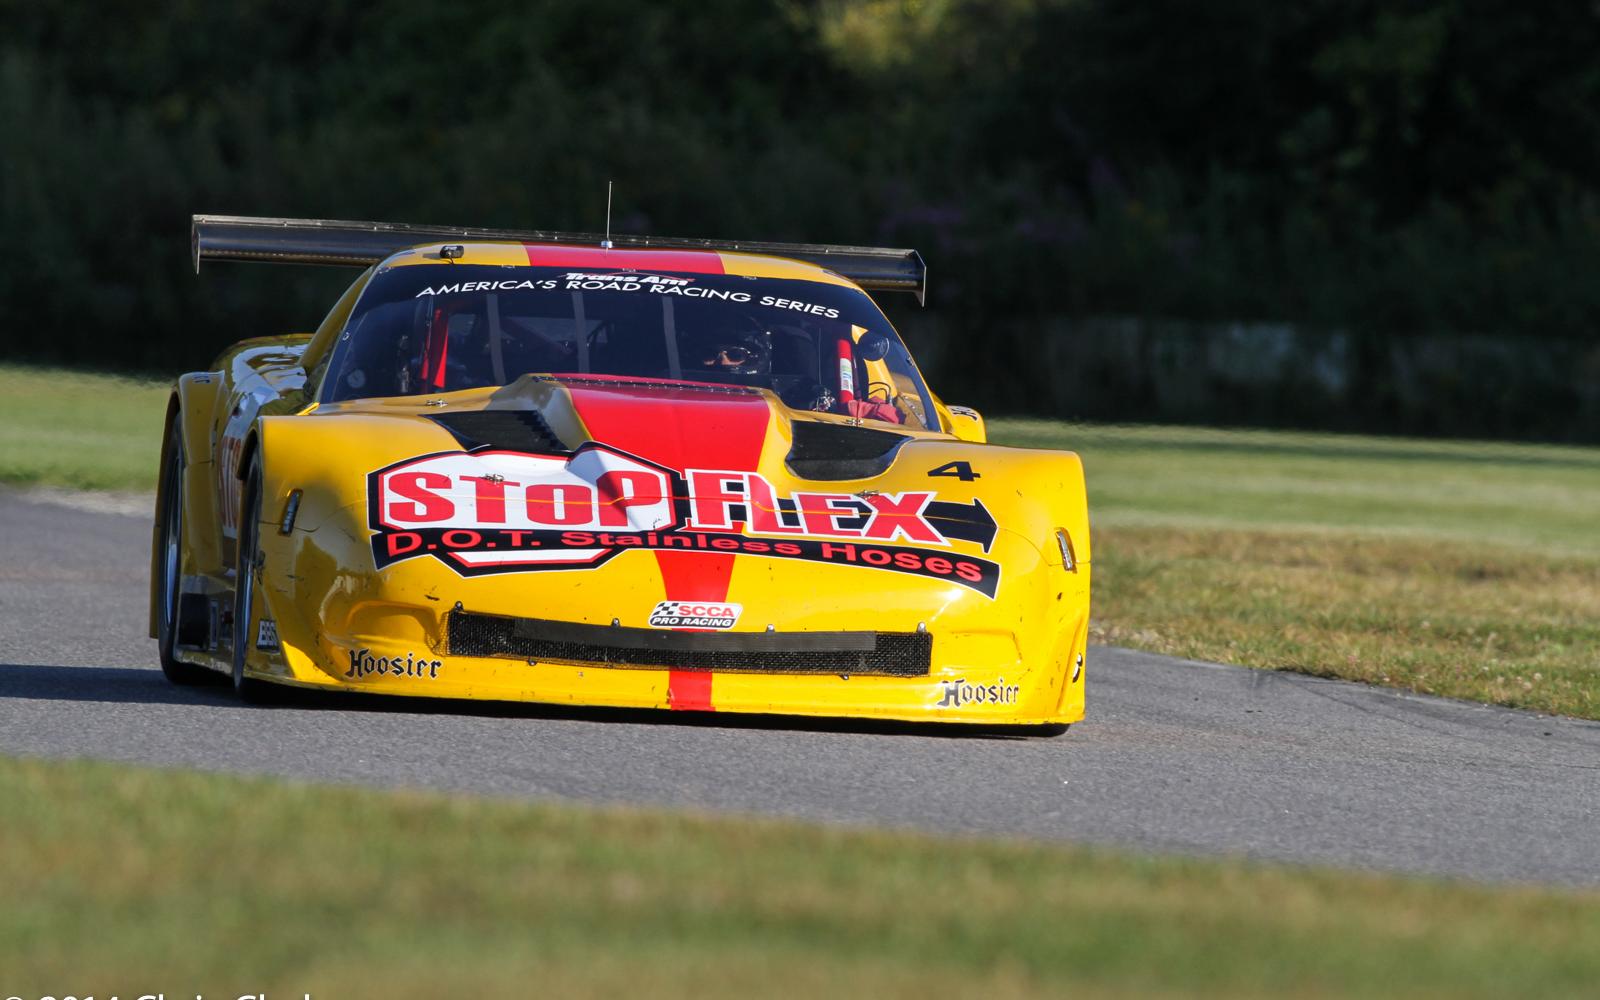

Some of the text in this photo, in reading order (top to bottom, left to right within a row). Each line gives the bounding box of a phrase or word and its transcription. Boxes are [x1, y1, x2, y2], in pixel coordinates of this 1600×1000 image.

[415, 280, 840, 319] AMERICA'S ROAD RACING SERIES
[928, 461, 980, 483] 4
[386, 530, 983, 583] D.O.T. Stainless Hoses
[652, 617, 732, 627] PRO RACING
[678, 605, 734, 617] SCCA
[344, 648, 442, 678] Hoosier
[937, 678, 1019, 707] Hoosier
